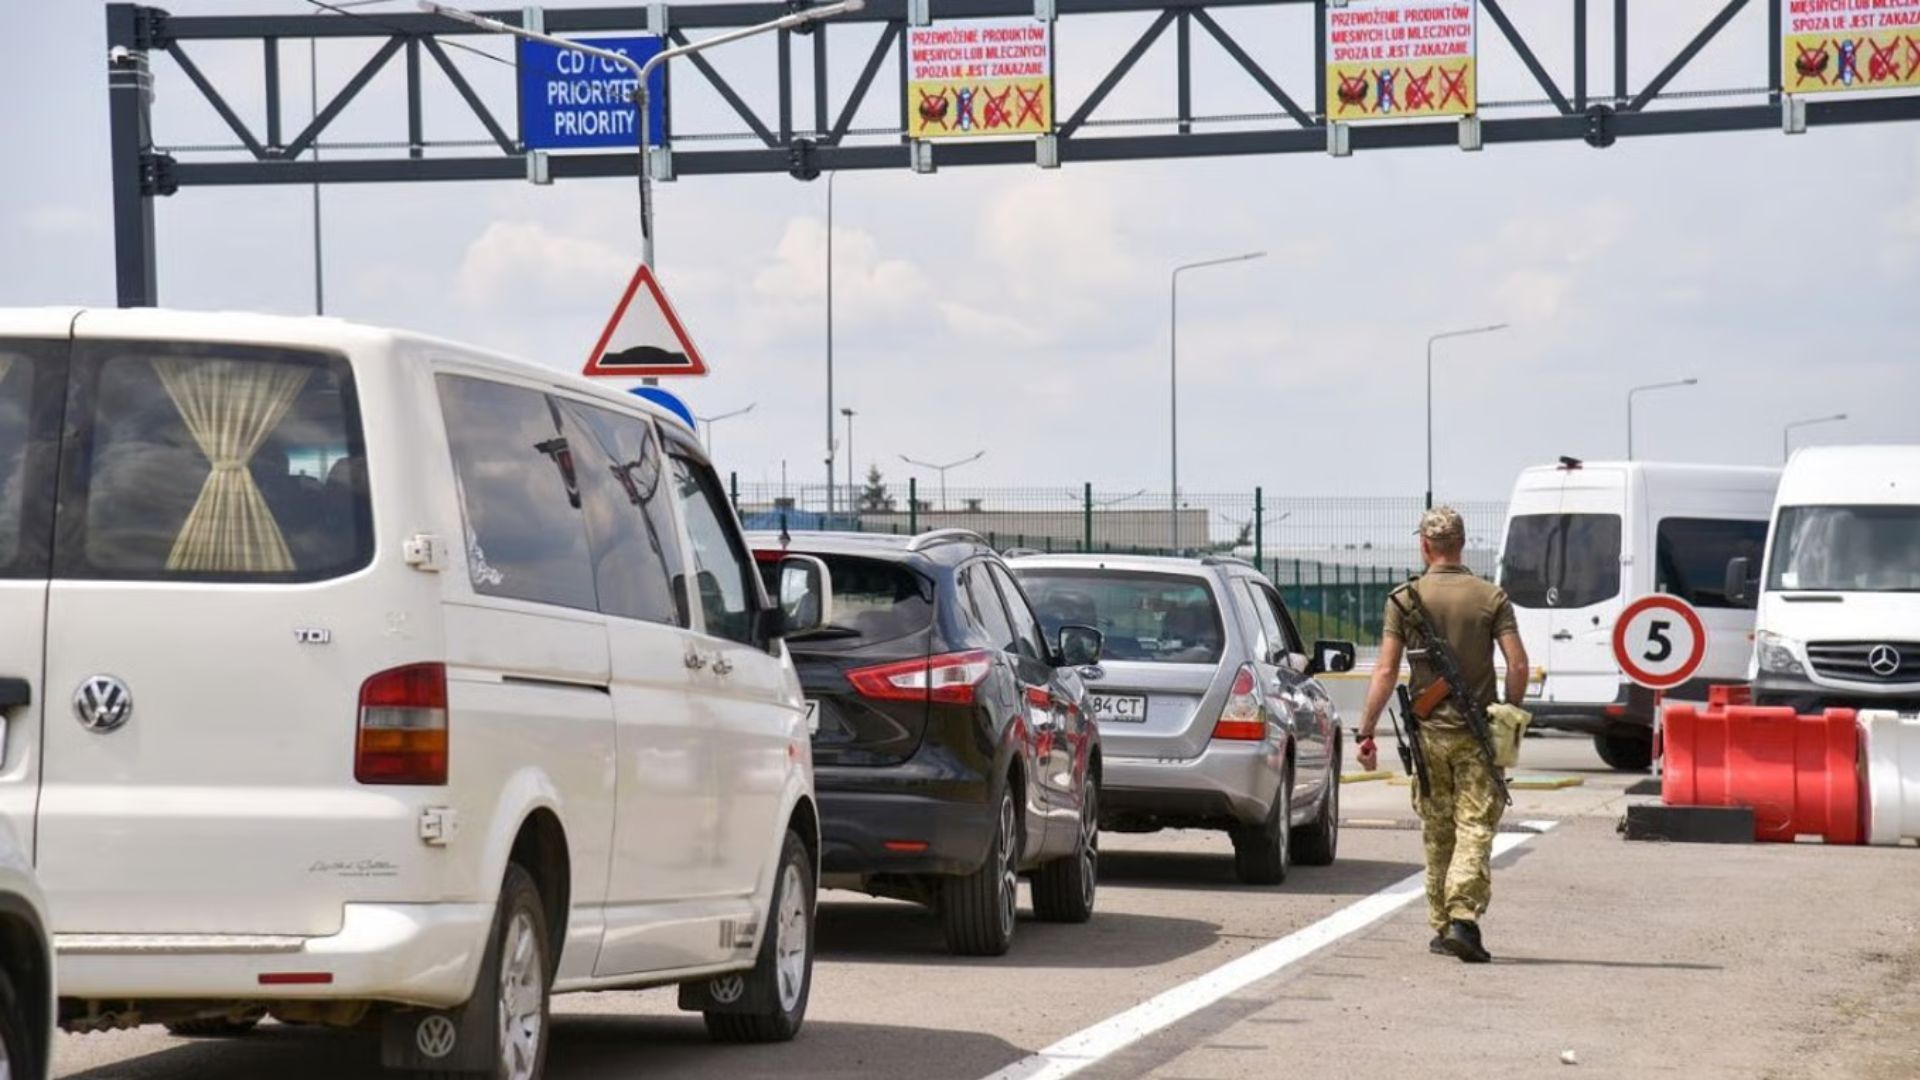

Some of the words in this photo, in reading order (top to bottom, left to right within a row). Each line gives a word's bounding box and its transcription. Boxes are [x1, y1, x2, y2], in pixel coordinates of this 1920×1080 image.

[1404, 3, 1469, 22] PRODUKTÓW
[1792, 17, 1830, 32] SPOZA
[1848, 14, 1874, 28] JEST
[982, 24, 1045, 42] PRODUKTÓW
[1386, 27, 1405, 41] LUB
[1407, 24, 1471, 40] MLECZNYCH
[964, 46, 983, 60] LUB
[986, 44, 1046, 59] MLECZNYCH
[1334, 46, 1369, 61] SPOZA
[1386, 44, 1410, 59] JEST
[1413, 41, 1468, 57] ZAKAZANE
[557, 50, 585, 75] CD
[915, 64, 948, 79] SPOZA
[966, 63, 988, 76] JEST
[992, 61, 1043, 76] ZAKAZANE
[554, 109, 636, 136] PRIORITY
[294, 628, 332, 644] TDI
[1643, 620, 1673, 663] 5
[1116, 698, 1141, 714] CT
